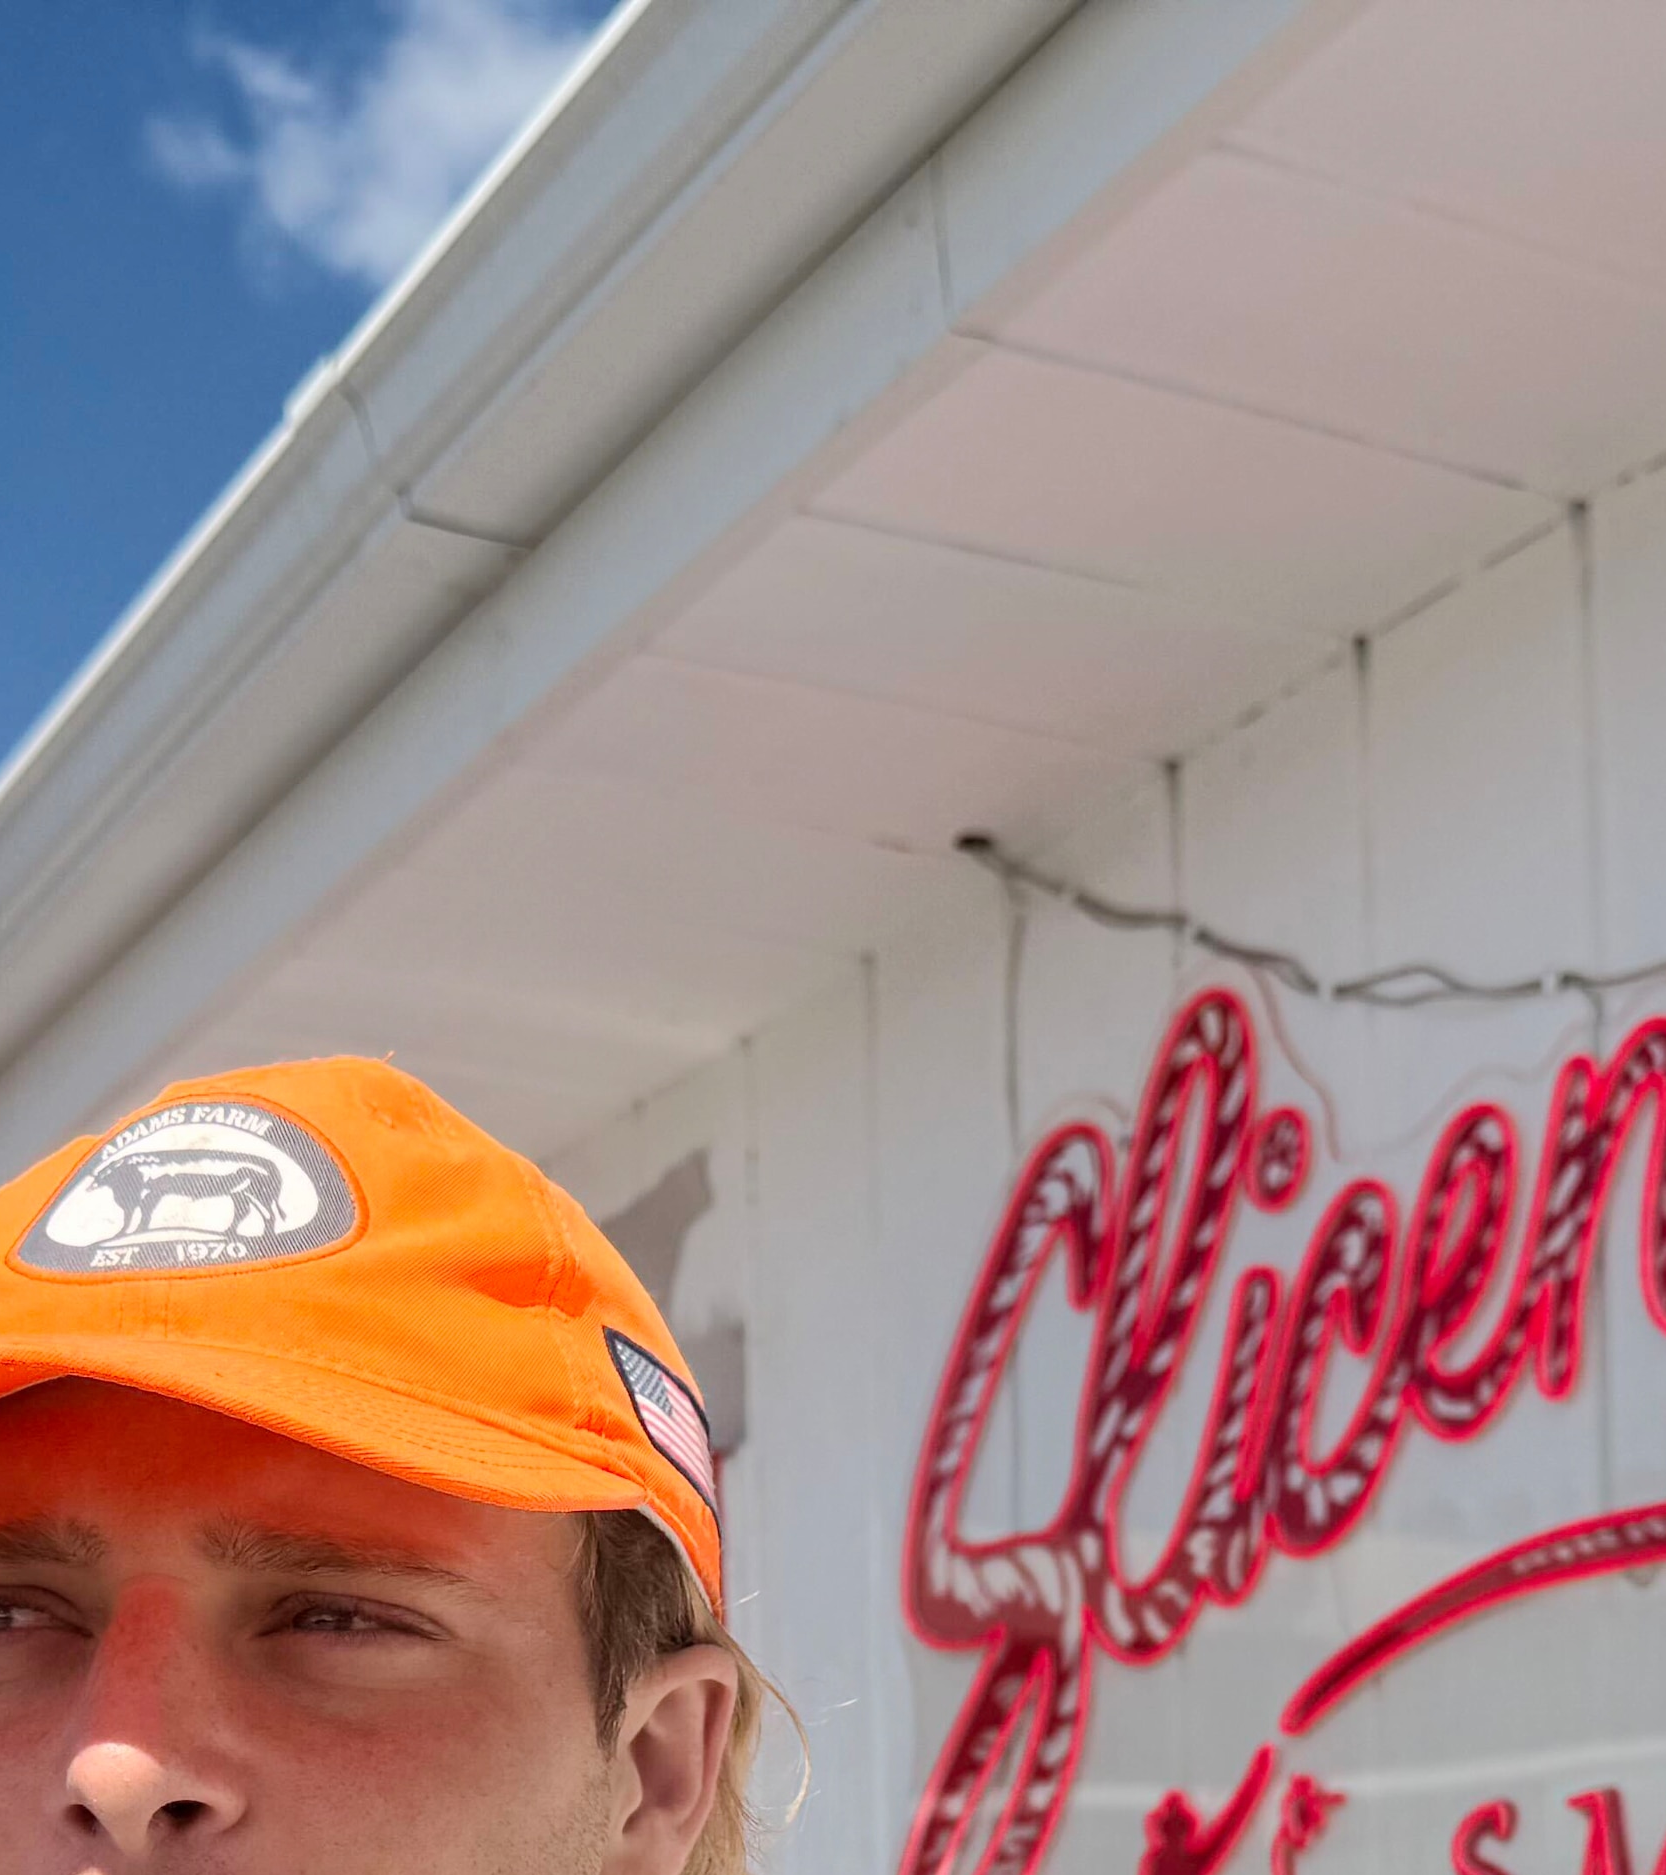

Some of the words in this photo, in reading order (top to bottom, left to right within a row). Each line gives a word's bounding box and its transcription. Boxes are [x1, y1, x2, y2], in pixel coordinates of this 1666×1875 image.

[100, 1107, 187, 1160] ADAMS
[191, 1106, 274, 1137] FARM
[90, 1247, 140, 1268] EST
[176, 1241, 248, 1263] 1970
